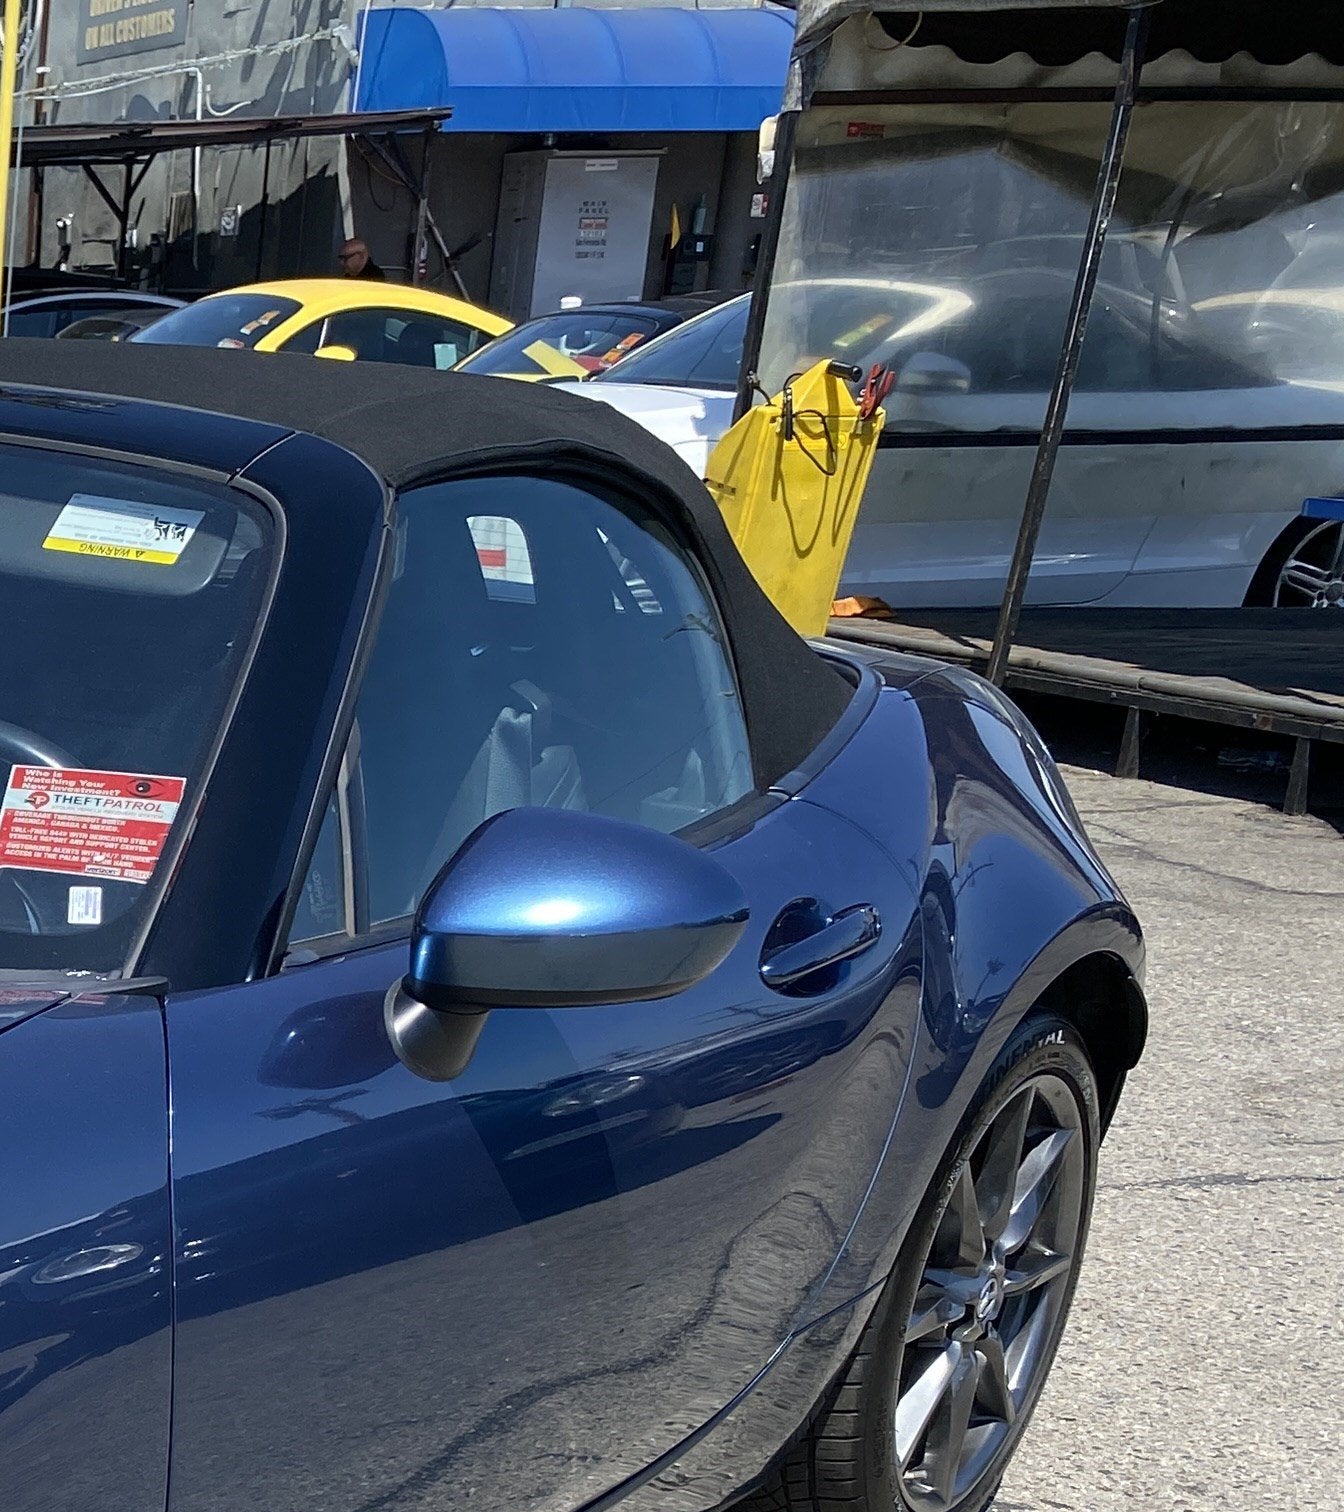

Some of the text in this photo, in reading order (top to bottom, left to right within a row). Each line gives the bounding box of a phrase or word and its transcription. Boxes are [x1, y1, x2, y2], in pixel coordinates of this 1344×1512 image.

[78, 543, 131, 557] WARNING
[25, 768, 51, 777] Who
[23, 776, 106, 788] Watching Your
[22, 782, 121, 797] New Investment?
[68, 838, 85, 846] AND
[85, 840, 120, 849] SUPPORT
[4, 848, 33, 857] ACCESS
[43, 852, 58, 860] THE
[58, 854, 80, 862] PALM
[52, 846, 80, 855] ALERTS
